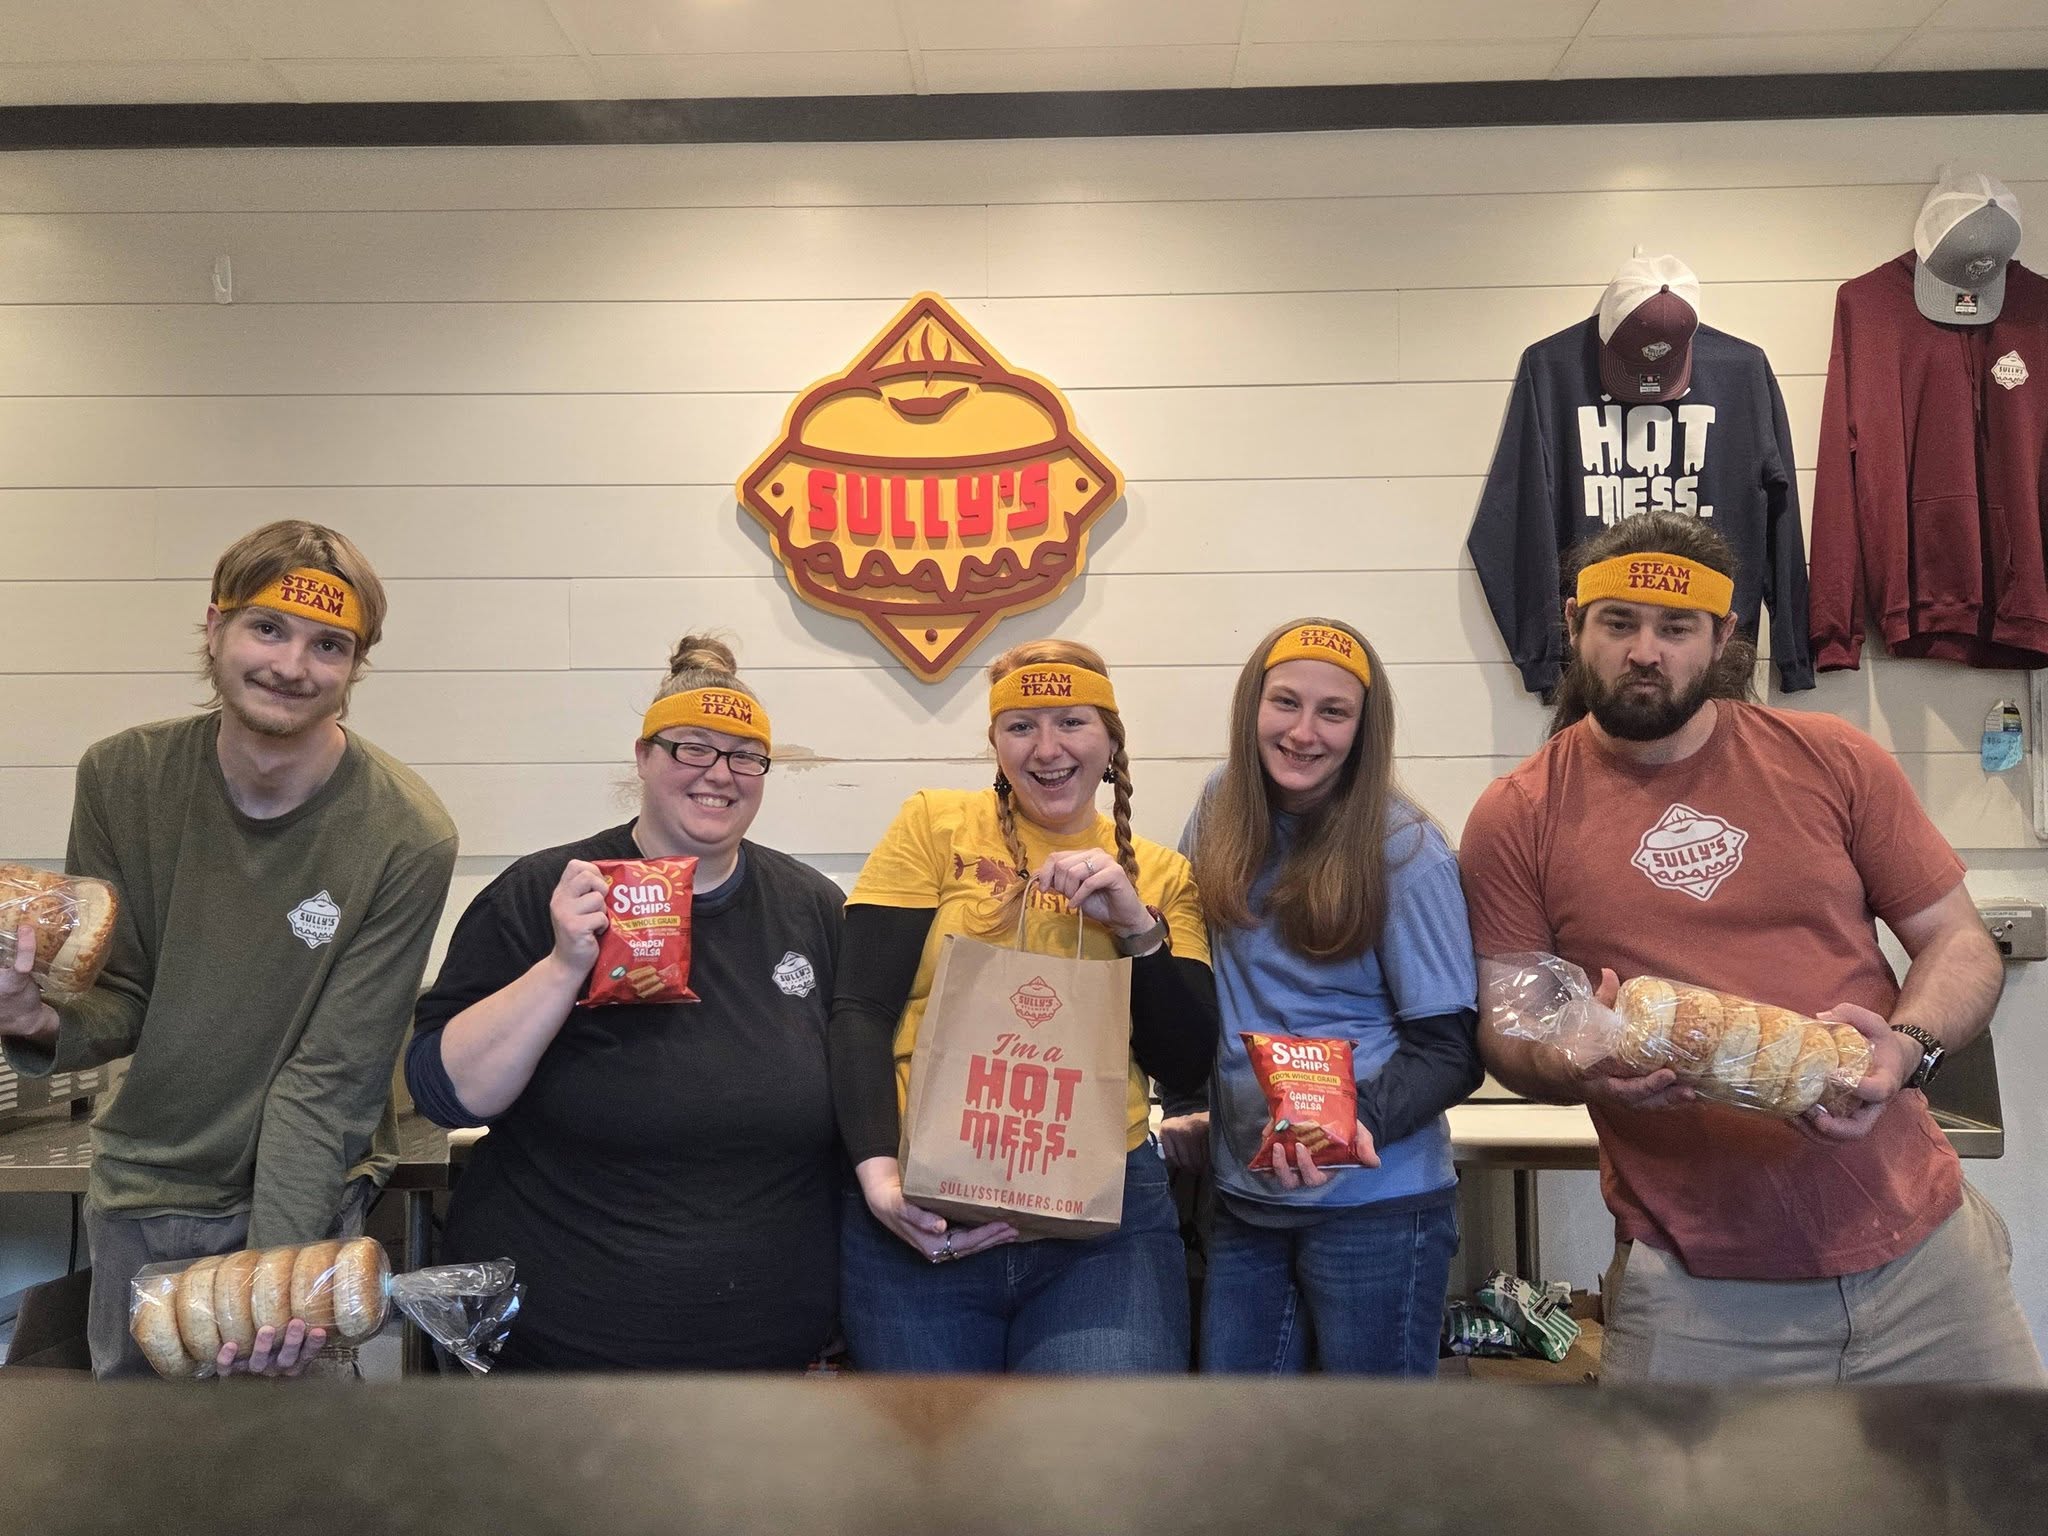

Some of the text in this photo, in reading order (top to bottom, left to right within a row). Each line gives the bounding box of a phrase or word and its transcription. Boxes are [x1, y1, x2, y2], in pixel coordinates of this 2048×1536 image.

[1577, 404, 1716, 477] HOT
[807, 460, 1050, 539] SULLY'S
[1583, 474, 1714, 528] MESS.
[1629, 562, 1691, 580] STEAM
[282, 574, 345, 602] STEAM
[1628, 574, 1690, 595] TEAM
[280, 586, 344, 617] TEAM
[1299, 636, 1352, 659] TEAM
[1300, 629, 1352, 649] STEAM
[1021, 672, 1072, 684] STEAM
[1021, 683, 1072, 697] TEAM
[701, 693, 752, 712] STEAM
[701, 702, 752, 725] TEAM
[1652, 836, 1728, 868] SULLY'S
[612, 884, 666, 914] Sun
[631, 902, 671, 916] CHIPS
[299, 912, 336, 927] SULLY'S
[631, 918, 657, 928] WHOLE
[657, 916, 678, 925] GRAIN
[629, 938, 665, 949] GARDEN
[632, 947, 661, 957] SALSA
[1019, 995, 1054, 1008] SULLY'S
[992, 1033, 1064, 1062] I'm a
[1271, 1041, 1325, 1065] Sun
[1291, 1059, 1330, 1073] CHIPS
[965, 1054, 1083, 1122] HOT
[1291, 1072, 1316, 1082] WHOLE
[1316, 1074, 1338, 1084] GRAIN
[1289, 1090, 1326, 1104] GARDEN
[1294, 1100, 1322, 1112] SALSA
[959, 1108, 1077, 1182] MESS.
[939, 1181, 1084, 1215] SULLYSSTEAMERS.COM
